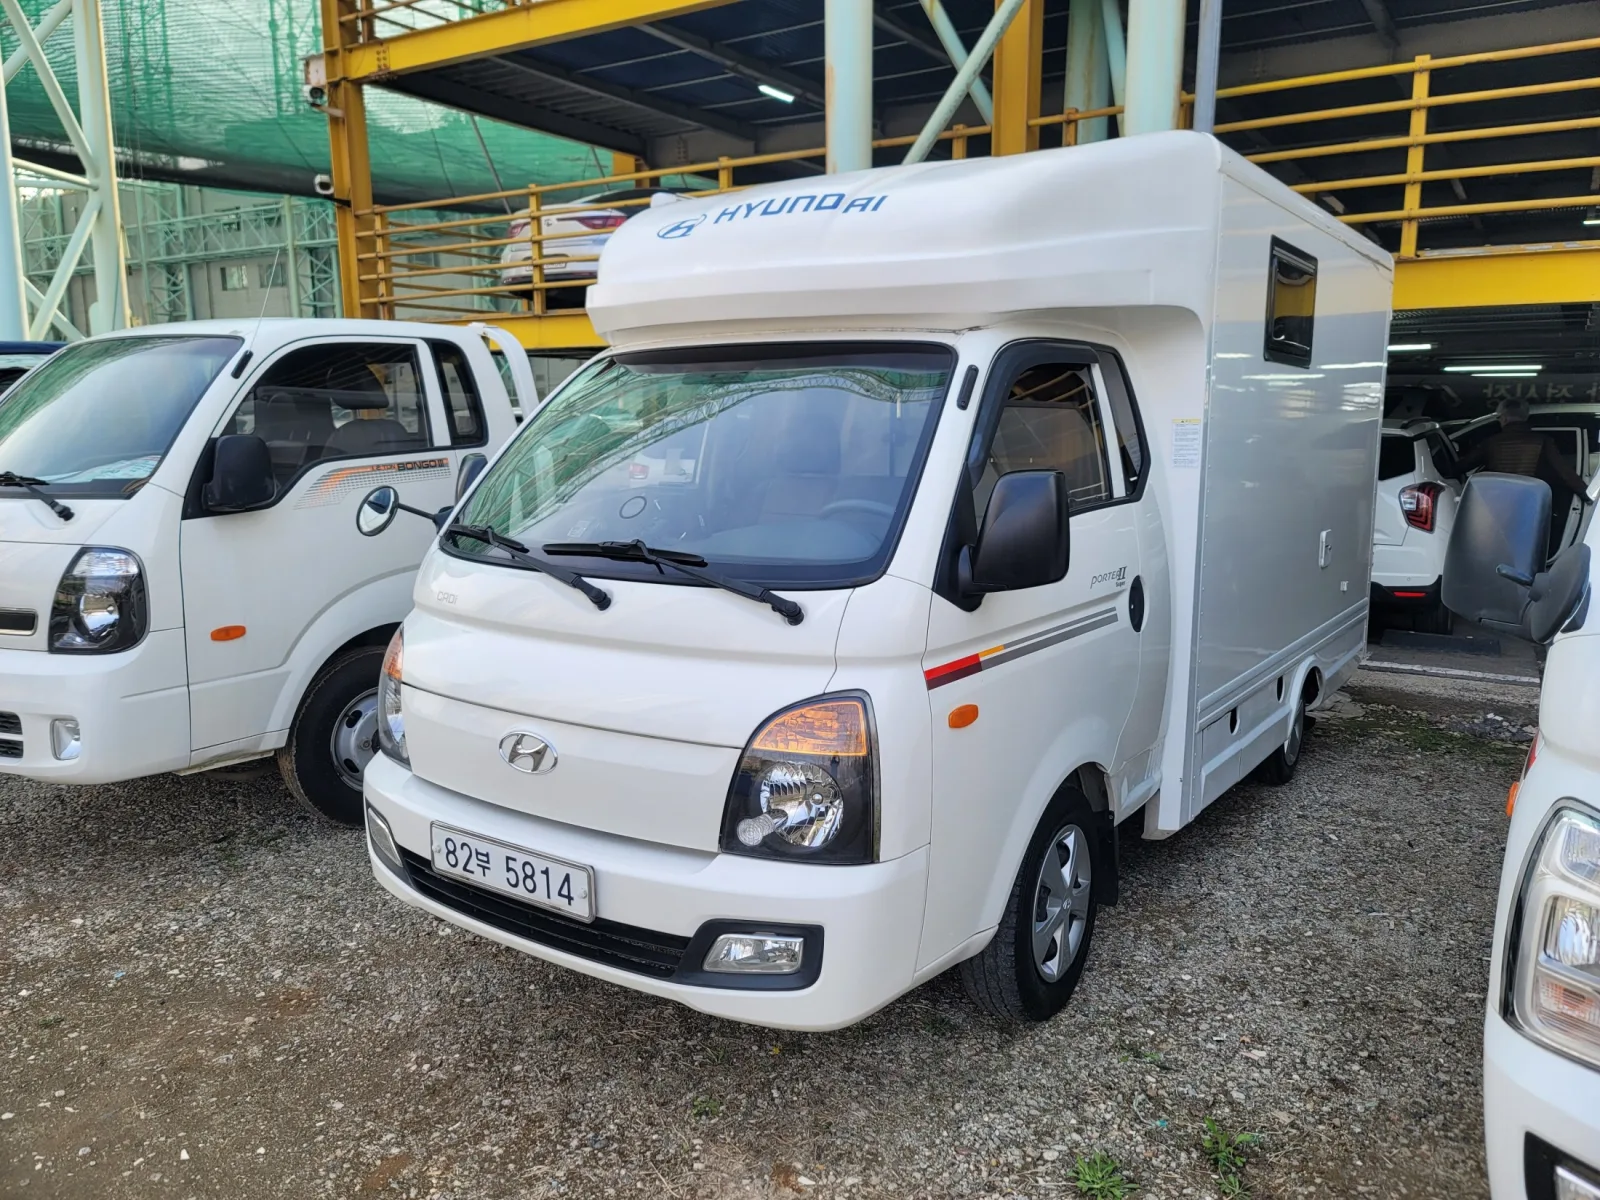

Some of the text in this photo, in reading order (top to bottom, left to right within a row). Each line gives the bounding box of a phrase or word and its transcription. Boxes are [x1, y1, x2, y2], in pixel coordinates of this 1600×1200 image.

[713, 193, 889, 224] HYUNDAI
[398, 460, 437, 471] BONGO
[444, 837, 574, 906] 82부 5814
